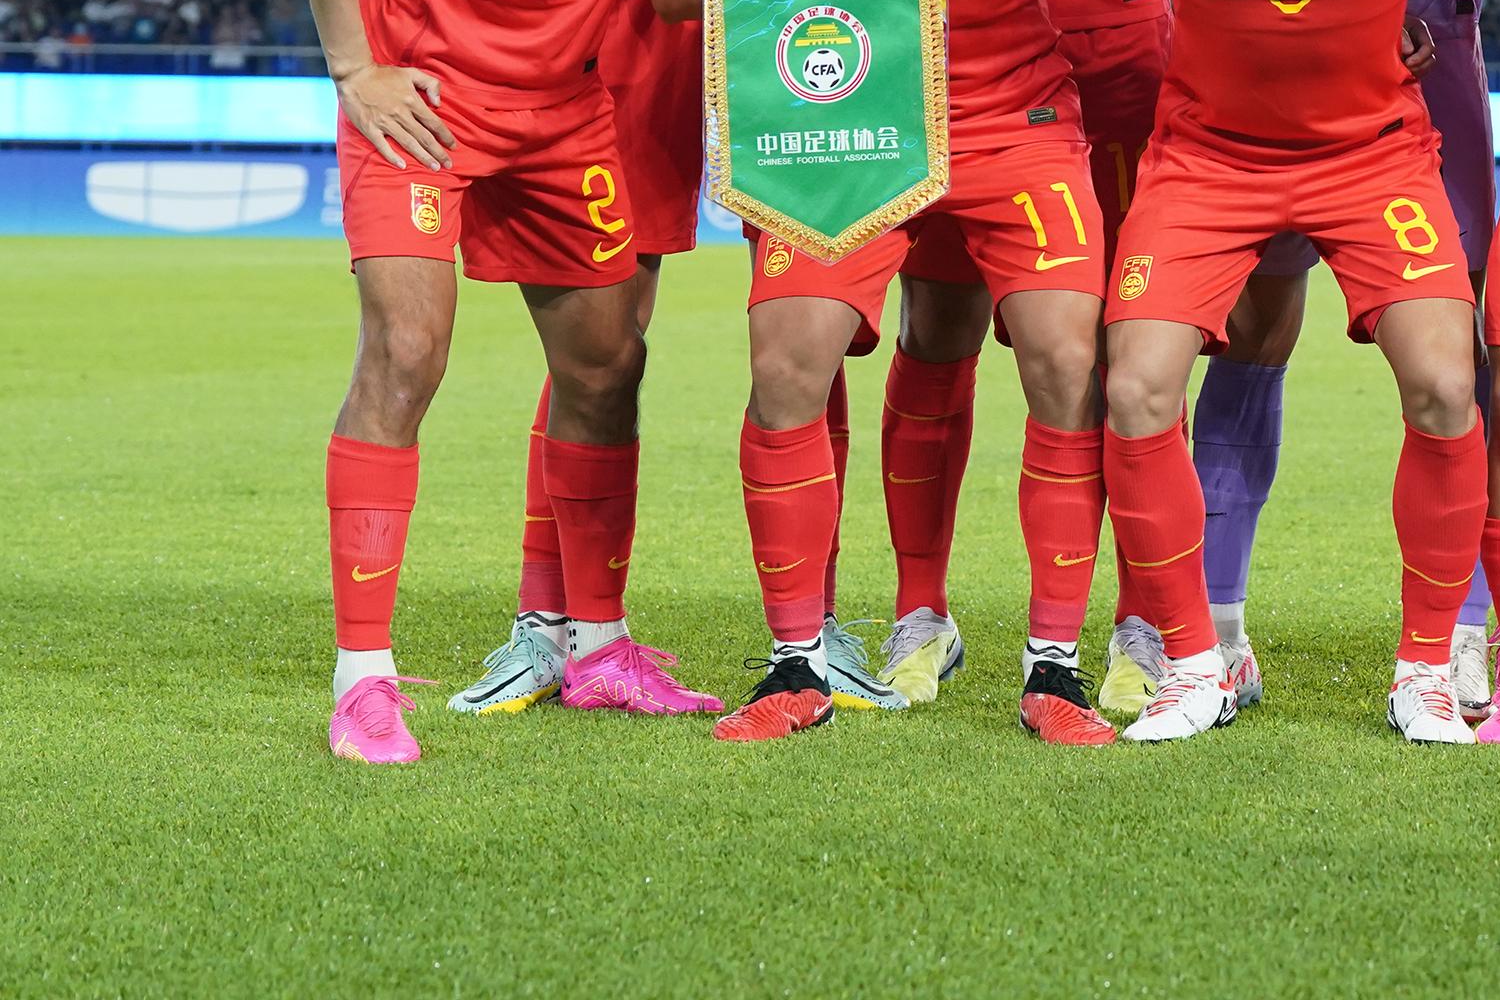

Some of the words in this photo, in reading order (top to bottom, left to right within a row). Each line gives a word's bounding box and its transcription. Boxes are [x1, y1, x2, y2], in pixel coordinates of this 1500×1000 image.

[811, 64, 837, 76] CFA
[756, 126, 899, 155] 中国足球协会
[757, 157, 793, 167] CHINESE
[797, 155, 840, 165] FOOTBALL
[844, 152, 900, 162] ASSOCIATION
[415, 188, 439, 200] CFA
[582, 165, 625, 233] 2
[1012, 182, 1087, 248] 11
[1383, 198, 1439, 255] 8
[1125, 260, 1149, 268] CFA
